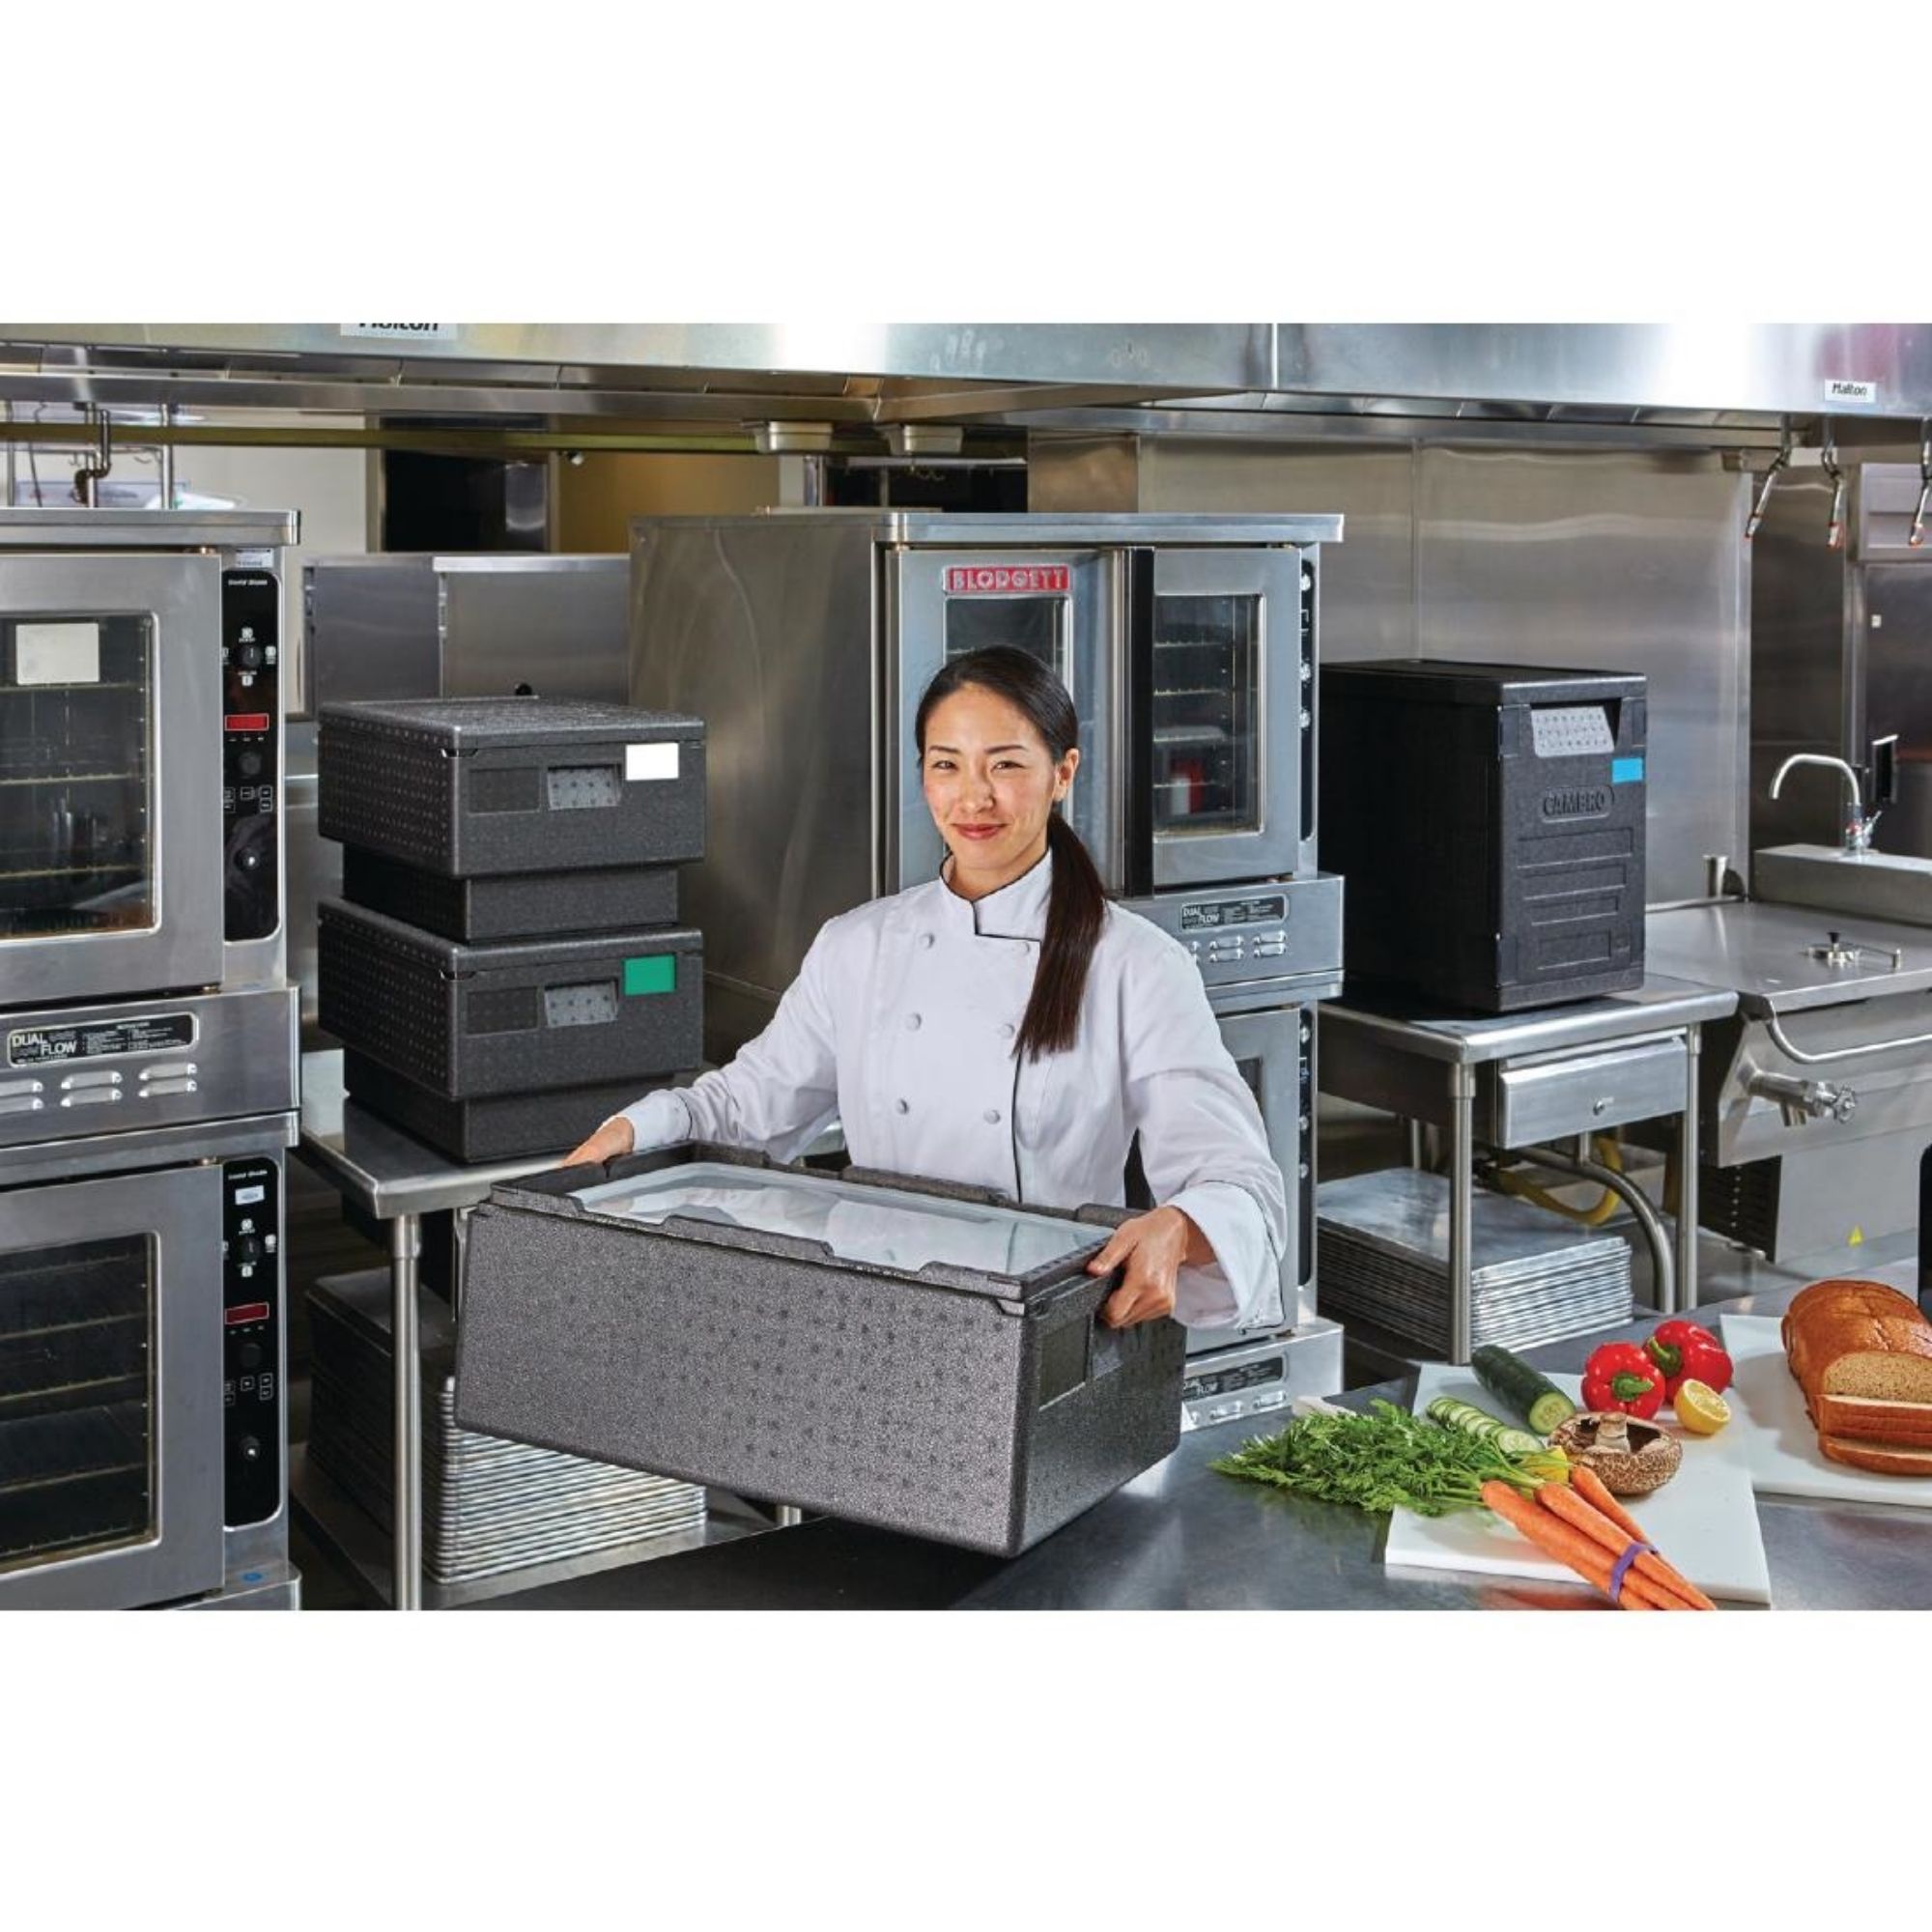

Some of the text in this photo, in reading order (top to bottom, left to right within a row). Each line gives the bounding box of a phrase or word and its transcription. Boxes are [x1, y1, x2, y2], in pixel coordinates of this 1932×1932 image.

[953, 569, 1064, 589] BLODGETT
[1544, 791, 1605, 816] CAMBRO
[12, 1034, 47, 1047] DUAL
[41, 1041, 76, 1055] FLOW
